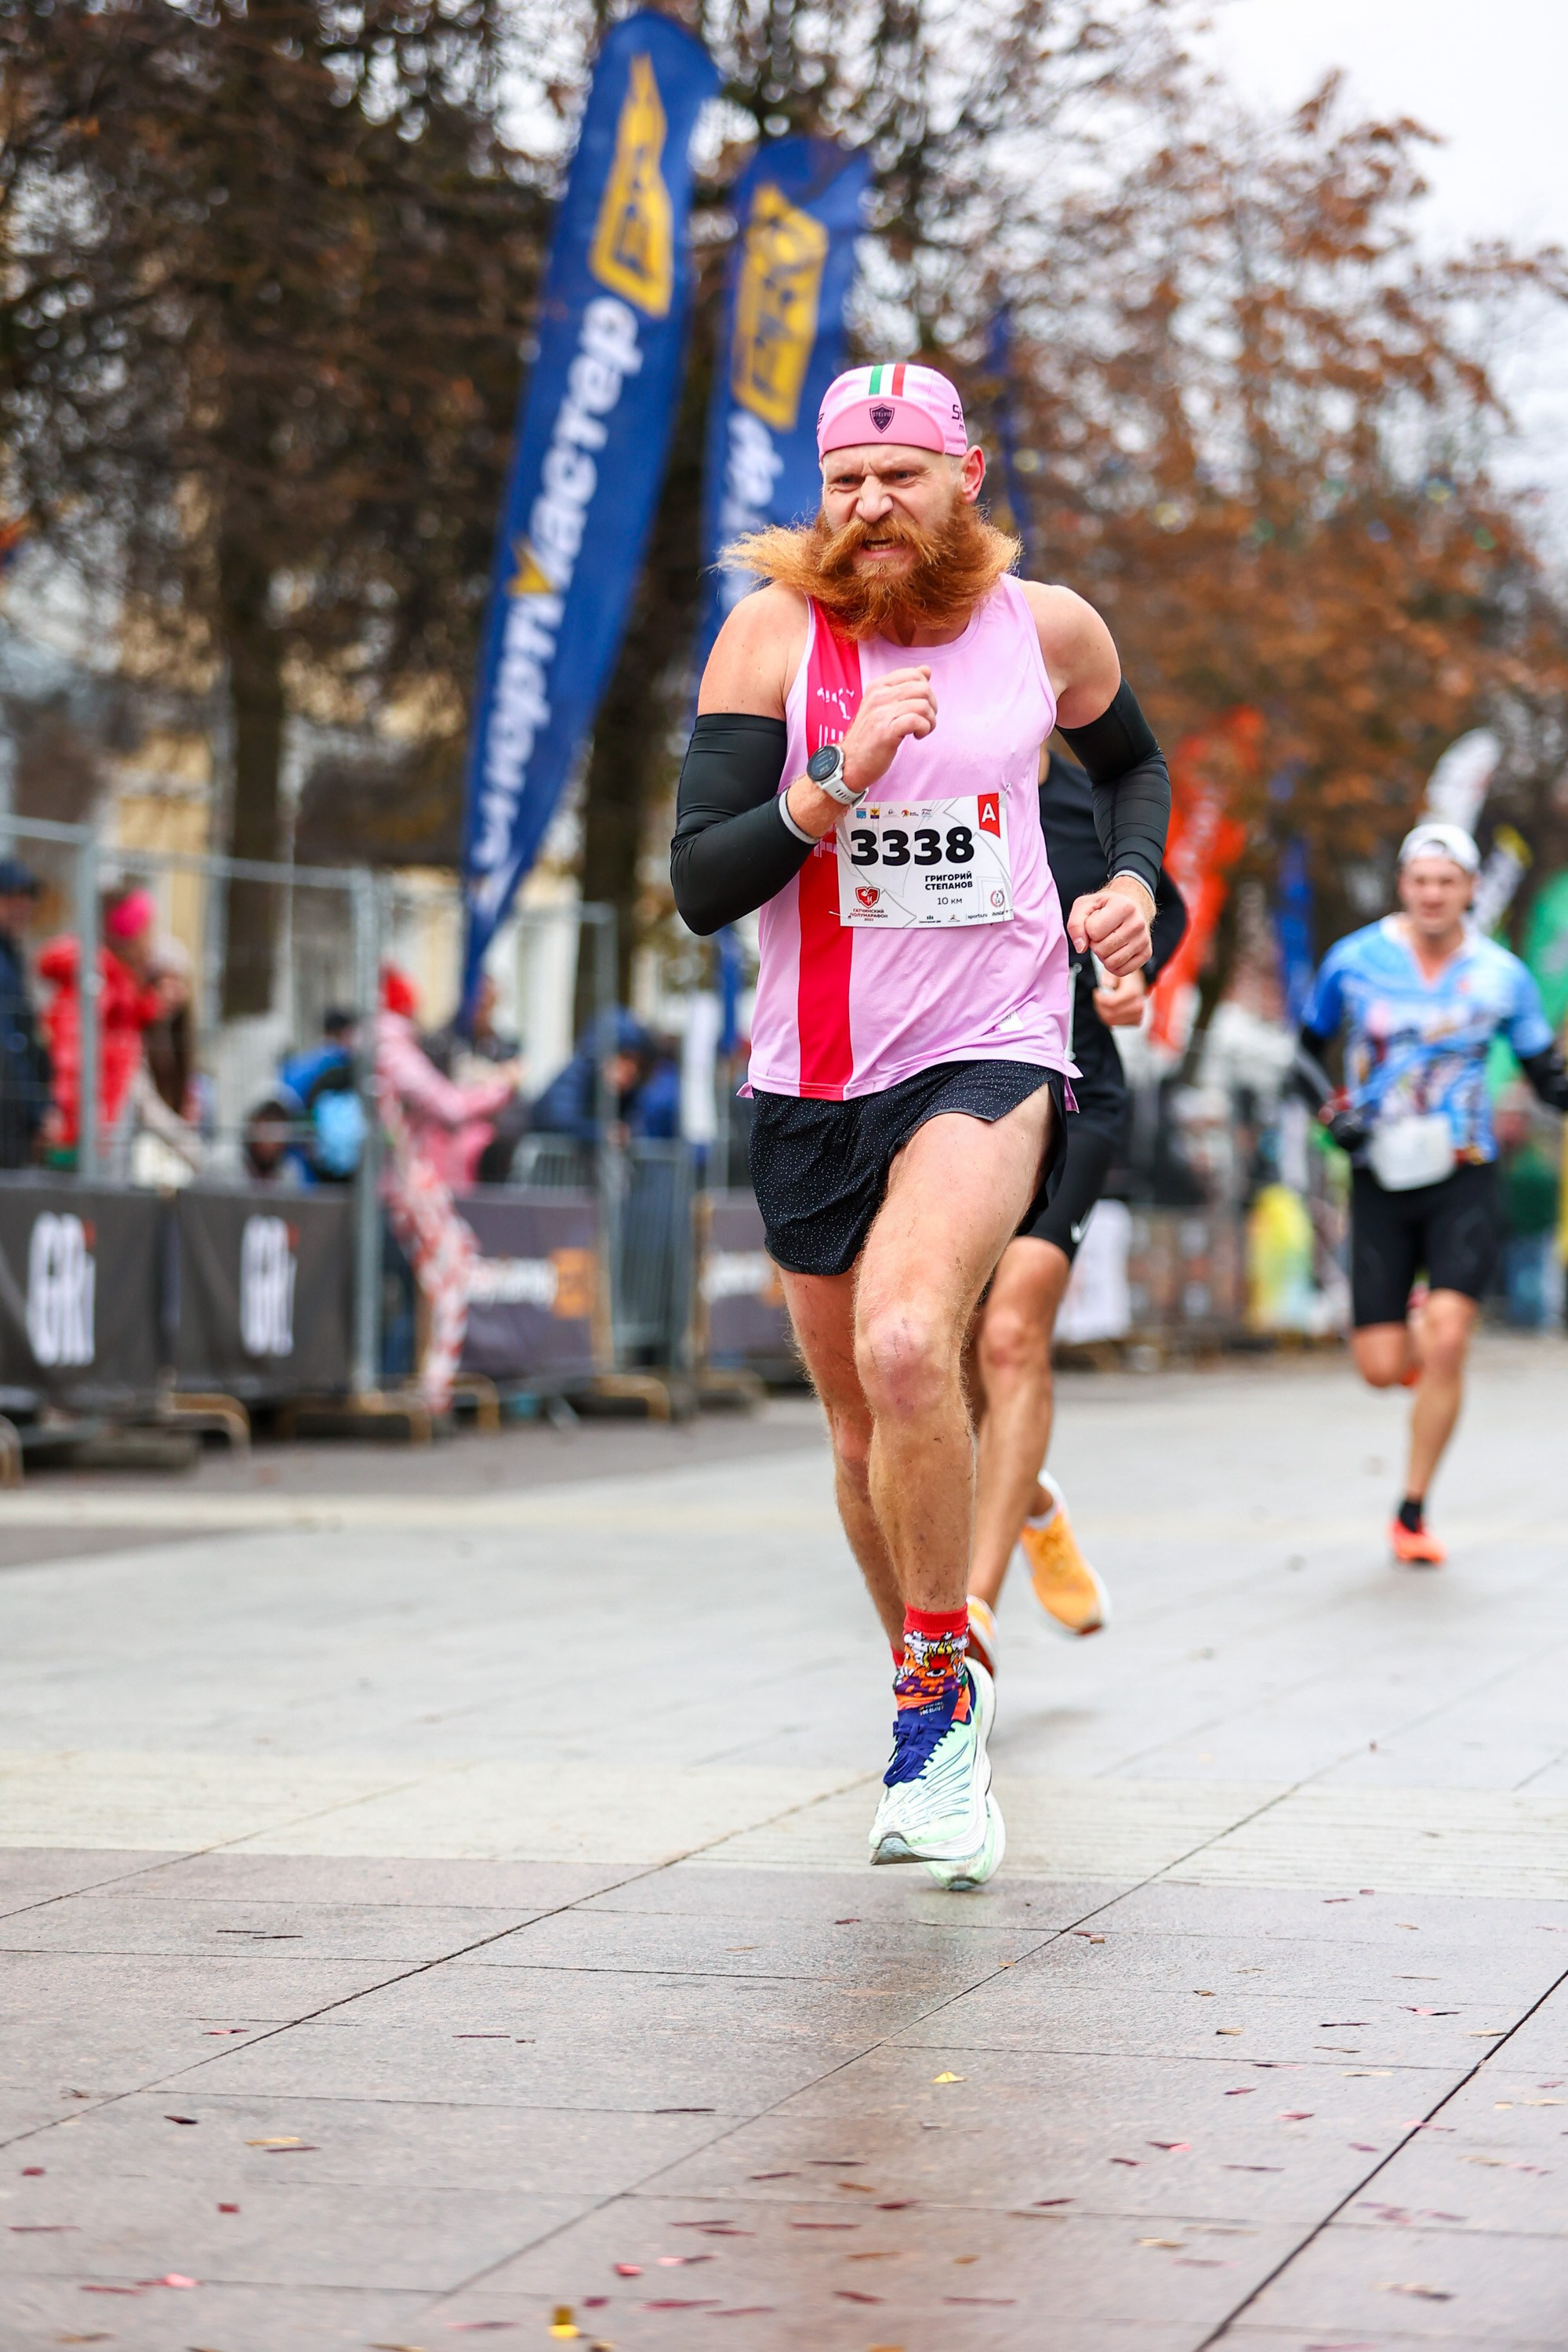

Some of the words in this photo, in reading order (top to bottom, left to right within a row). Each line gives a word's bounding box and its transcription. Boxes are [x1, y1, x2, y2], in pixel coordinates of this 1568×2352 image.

[851, 826, 975, 866] 3338
[924, 870, 972, 882] ГРИГОРИЙ
[924, 880, 973, 891] СТЕПАНОВ
[937, 897, 949, 906] 10
